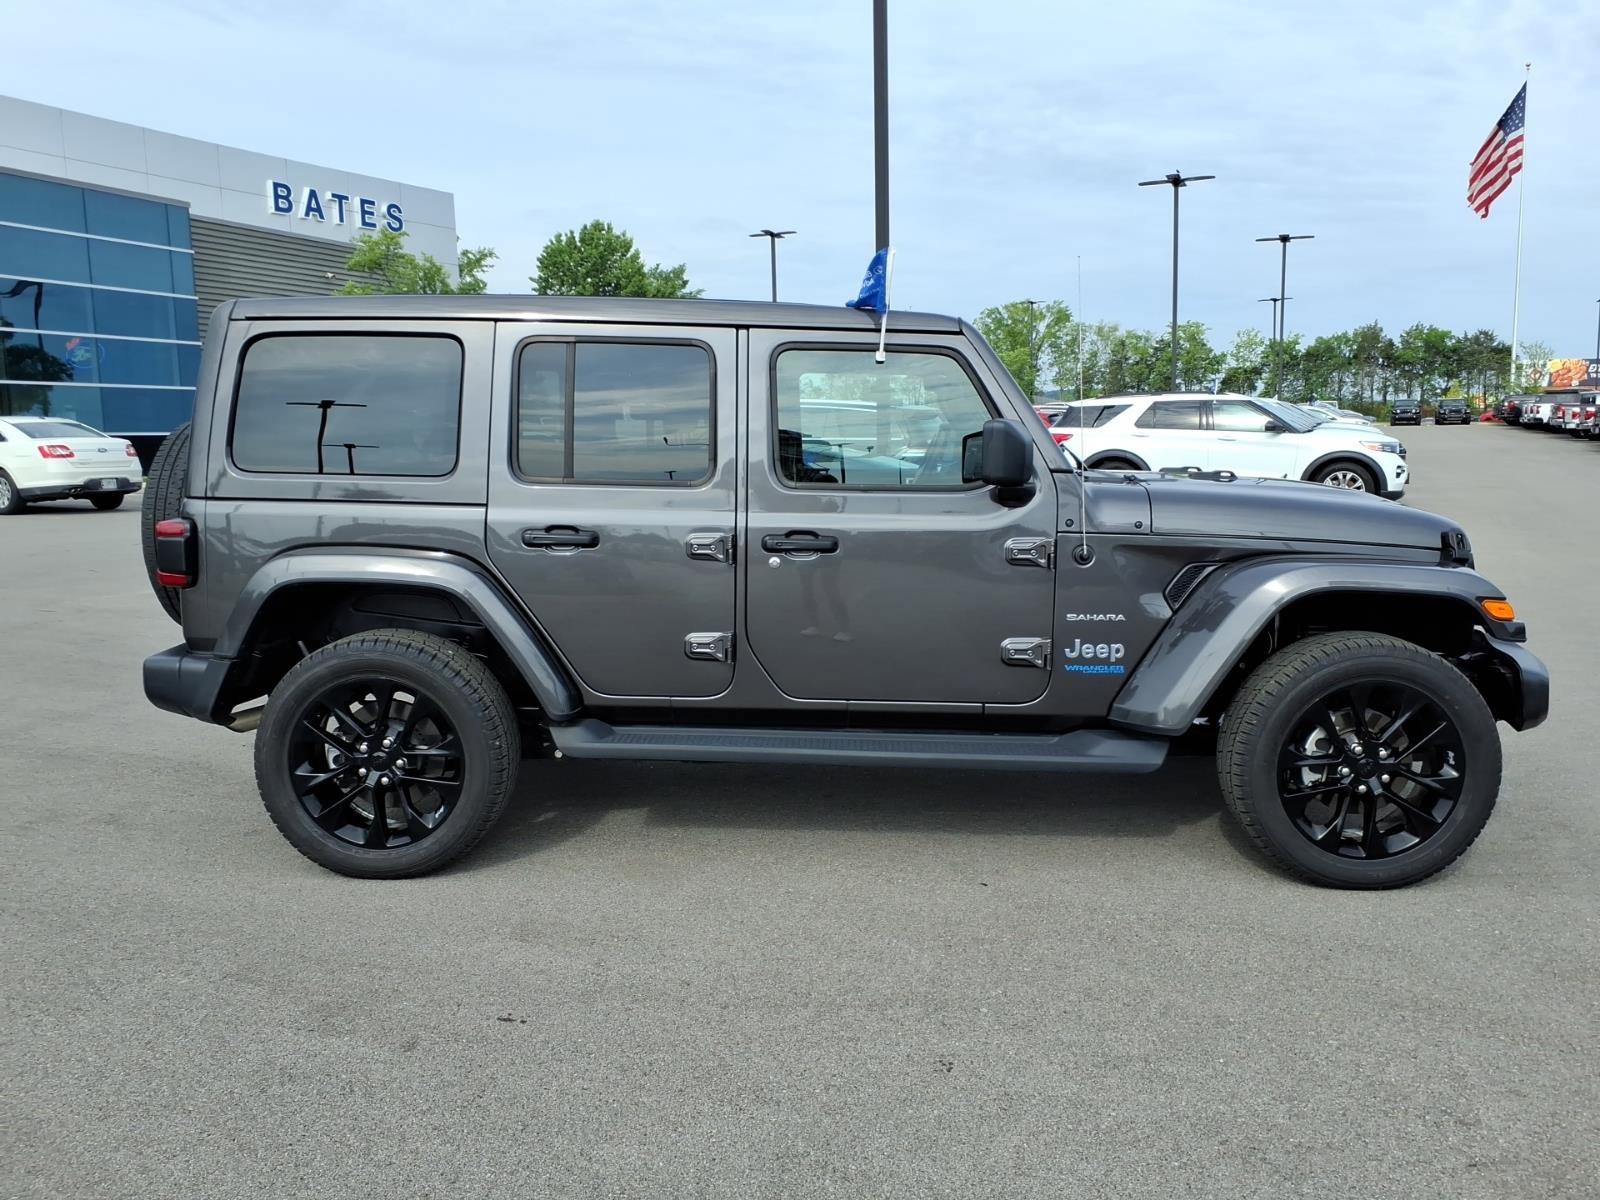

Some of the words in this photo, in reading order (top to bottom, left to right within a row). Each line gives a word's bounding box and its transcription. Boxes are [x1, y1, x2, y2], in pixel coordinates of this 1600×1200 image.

[267, 180, 405, 233] BATES
[1065, 613, 1126, 621] SAHARA
[1063, 639, 1125, 662] Jeep
